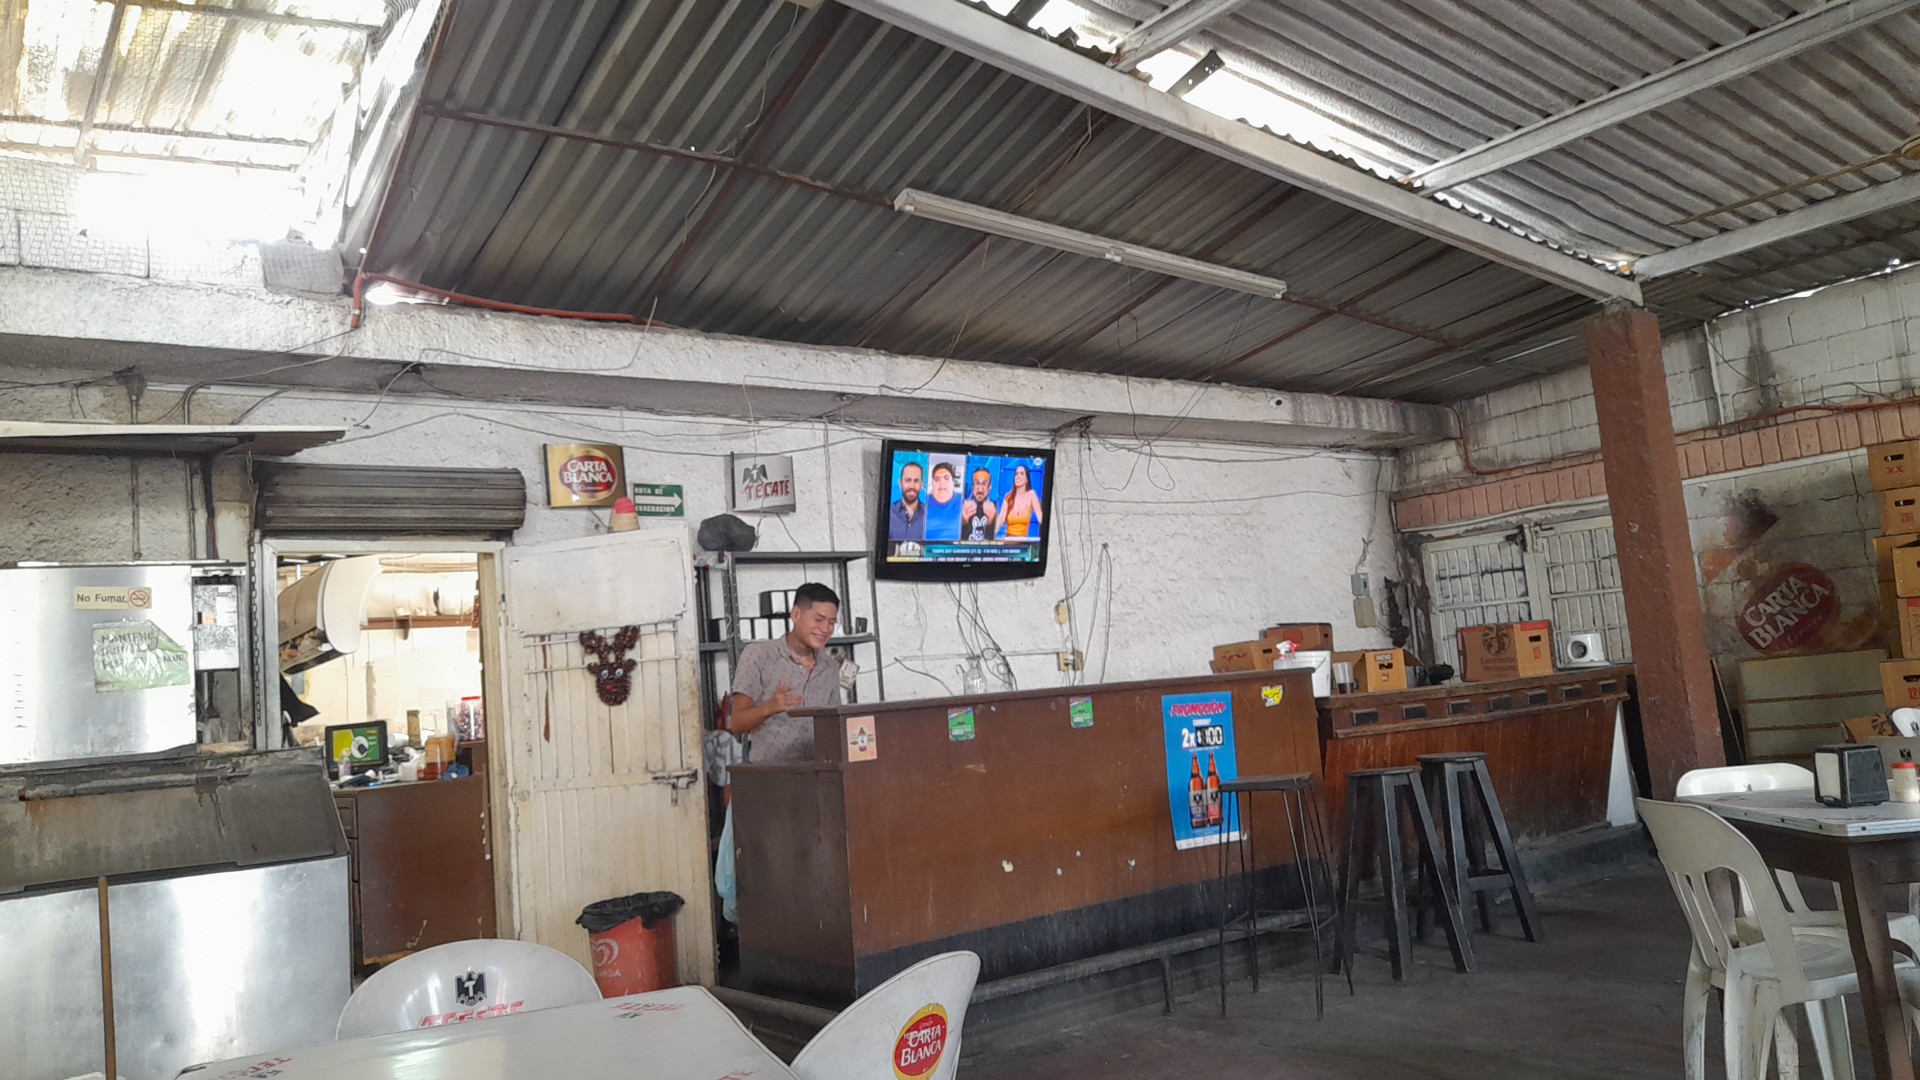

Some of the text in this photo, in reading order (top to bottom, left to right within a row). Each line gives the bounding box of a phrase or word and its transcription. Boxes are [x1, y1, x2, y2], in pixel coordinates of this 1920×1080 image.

[567, 459, 608, 473] CARTA
[563, 471, 613, 484] BLANCA
[744, 479, 790, 501] TECATE
[76, 594, 126, 603] No Fumar
[1743, 577, 1803, 627] CARTA
[1748, 583, 1830, 649] BLANCA
[1169, 699, 1226, 717] PROMOCIÓN
[1181, 727, 1196, 748] 2x
[908, 1024, 941, 1047] CARTA
[901, 1040, 941, 1067] BLANCA
